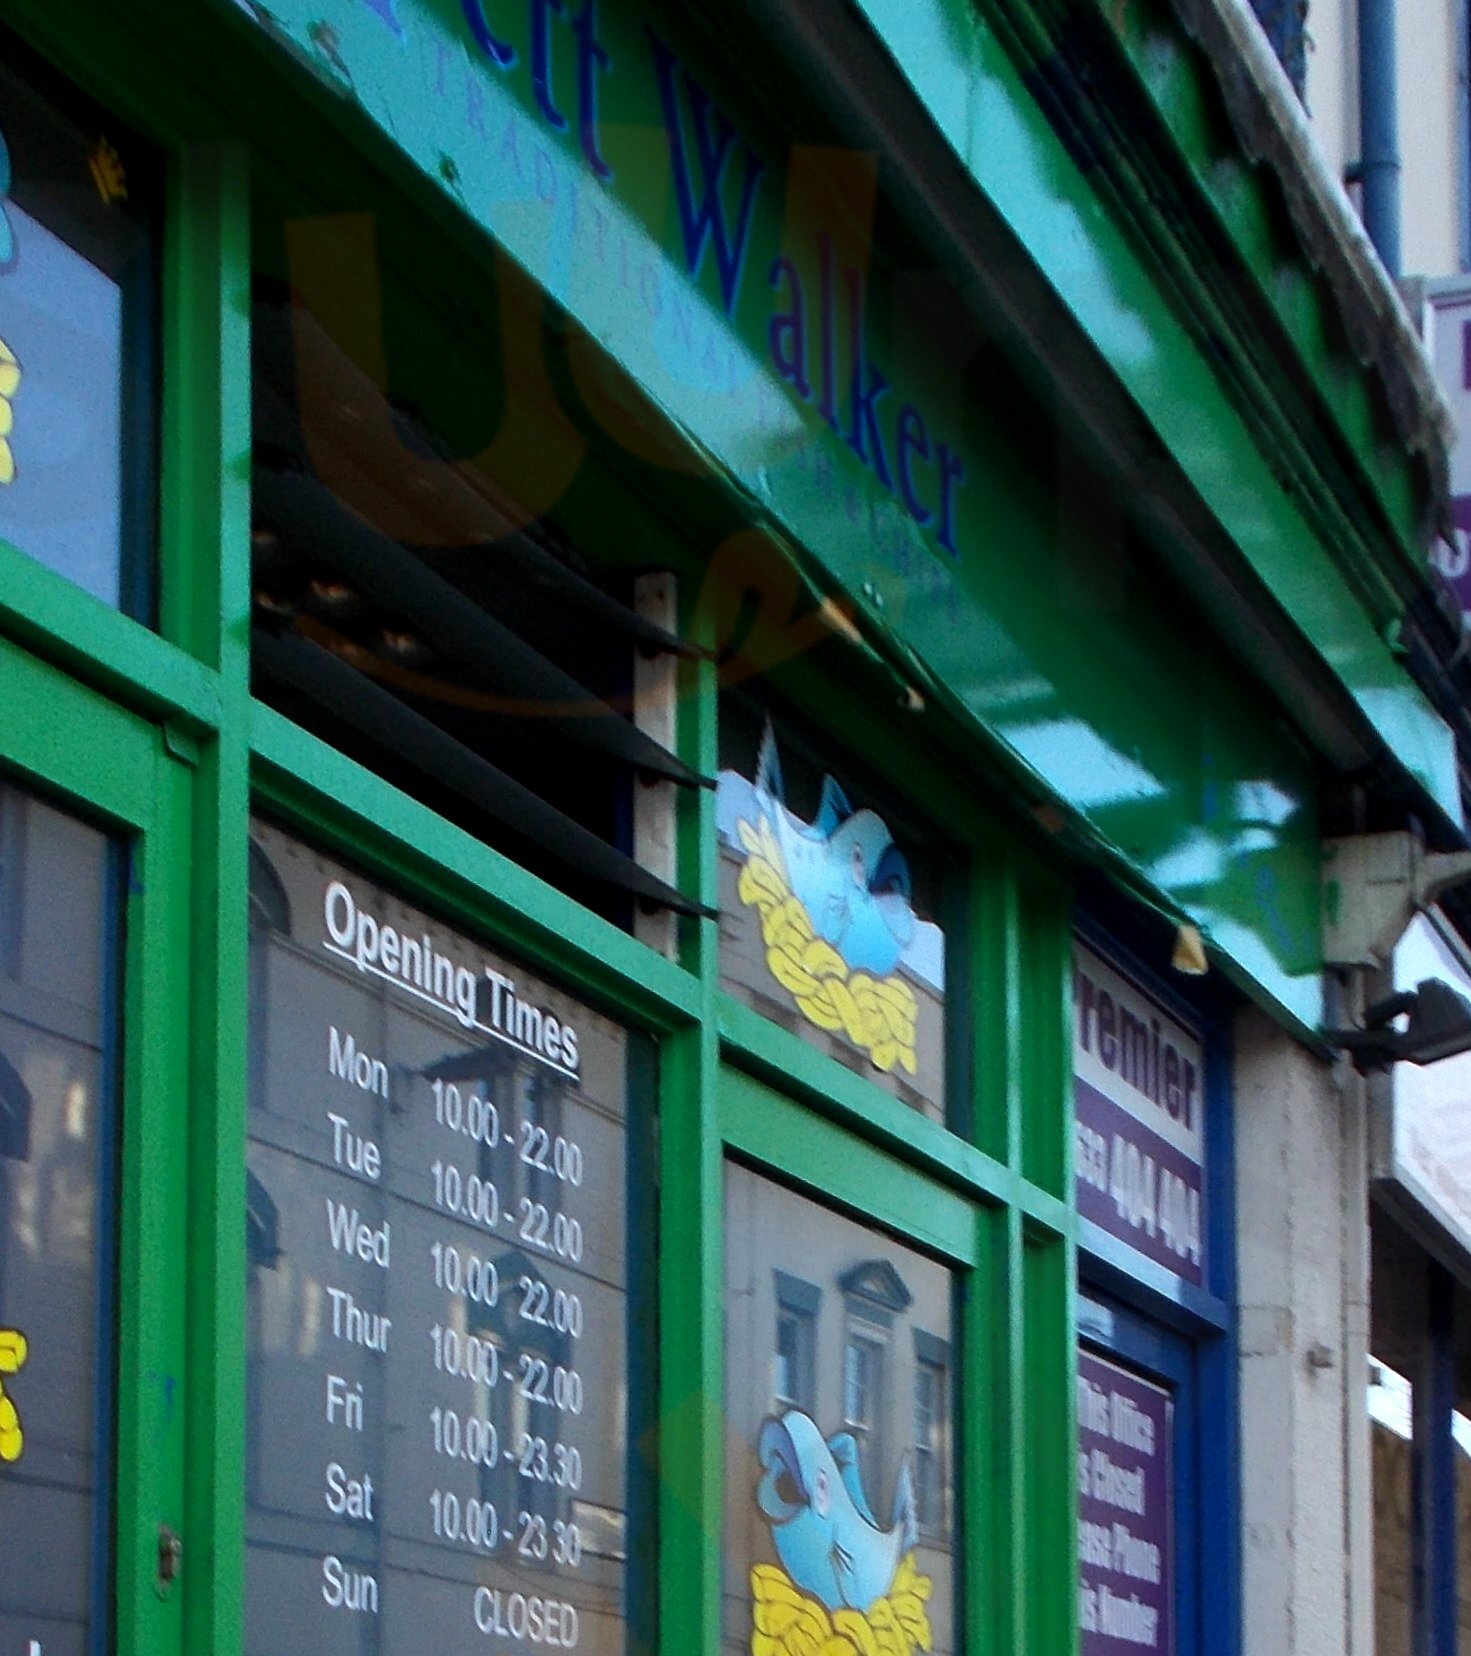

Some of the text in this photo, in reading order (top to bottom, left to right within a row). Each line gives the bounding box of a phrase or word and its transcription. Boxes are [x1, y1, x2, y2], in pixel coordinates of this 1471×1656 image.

[648, 20, 965, 560] Walker
[324, 881, 580, 1071] Opening Times
[329, 1026, 389, 1100] Mon
[432, 1078, 499, 1148] 10.00
[520, 1120, 583, 1187] 22.00
[1077, 969, 1196, 1131] remier
[328, 1113, 382, 1180] Tue
[431, 1160, 499, 1229] 10.00
[520, 1197, 583, 1263] 22.00
[327, 1199, 583, 1340] Wed 10.00 22.00
[326, 1286, 391, 1353] Thur
[430, 1322, 499, 1388] 10.00
[518, 1353, 583, 1416] 22.00
[326, 1462, 374, 1522] Sat
[429, 1488, 498, 1549] 10.00
[327, 1376, 364, 1433] Fri
[430, 1405, 499, 1470] 10.00
[518, 1433, 583, 1491] 23.30
[322, 1556, 579, 1648] Sun CLOSED
